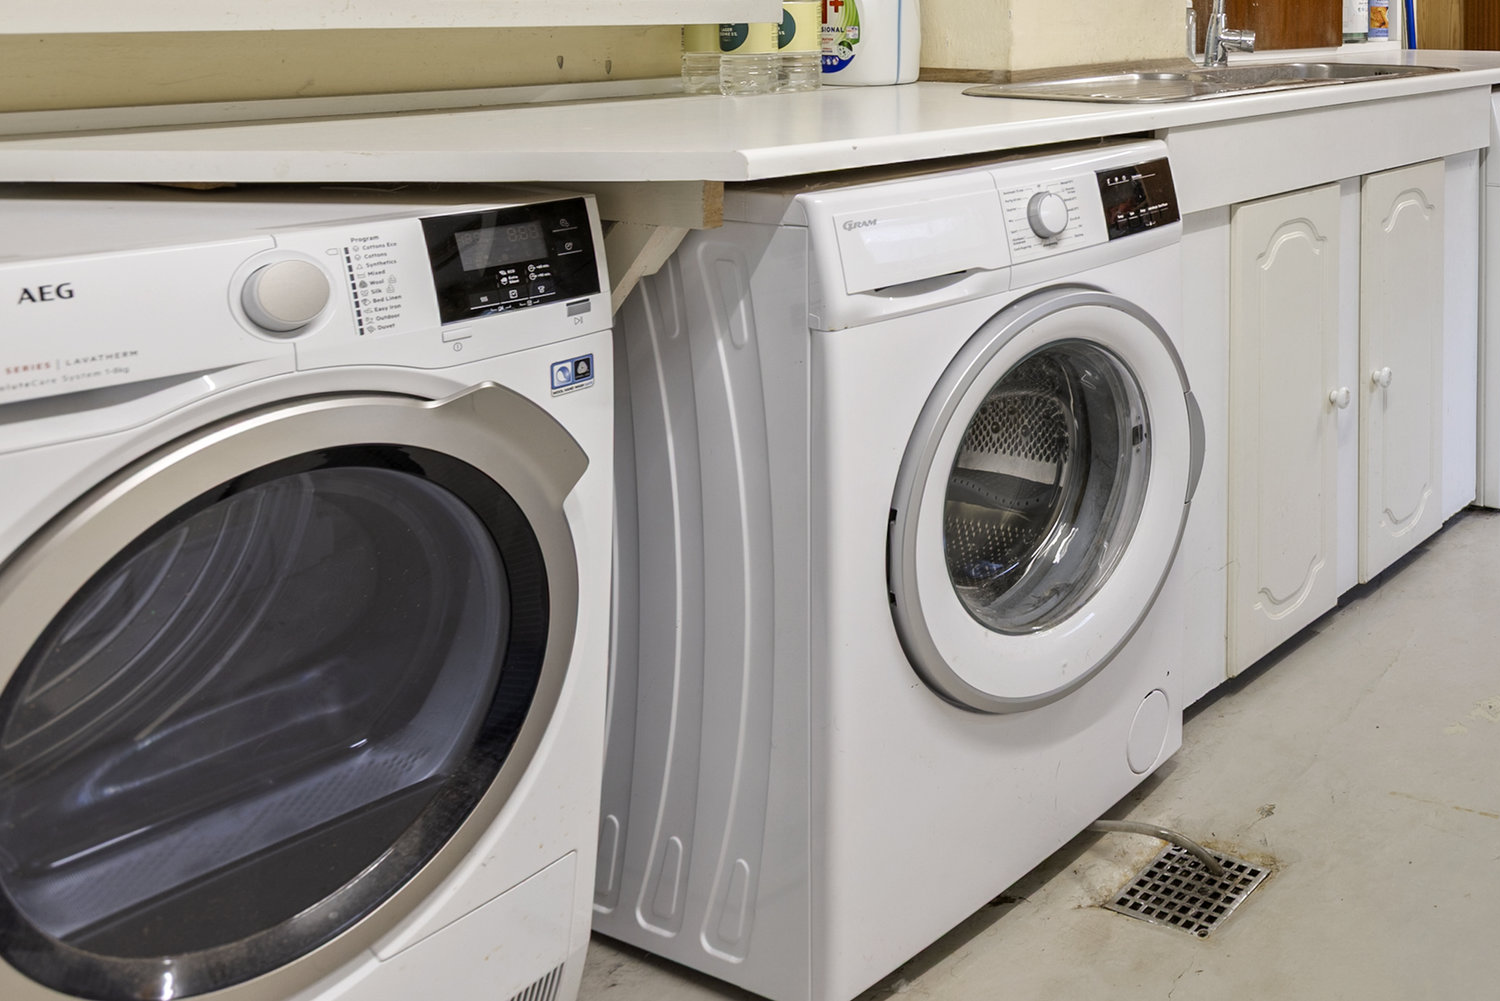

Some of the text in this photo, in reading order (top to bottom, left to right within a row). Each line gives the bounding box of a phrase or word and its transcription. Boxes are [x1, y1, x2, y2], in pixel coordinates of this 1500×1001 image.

[350, 234, 379, 243] Program
[365, 259, 397, 268] Synthetics
[18, 282, 75, 304] AEG
[375, 313, 400, 321] Outdoor
[5, 350, 138, 375] SERIES LAVATHERM
[62, 370, 102, 382] System
